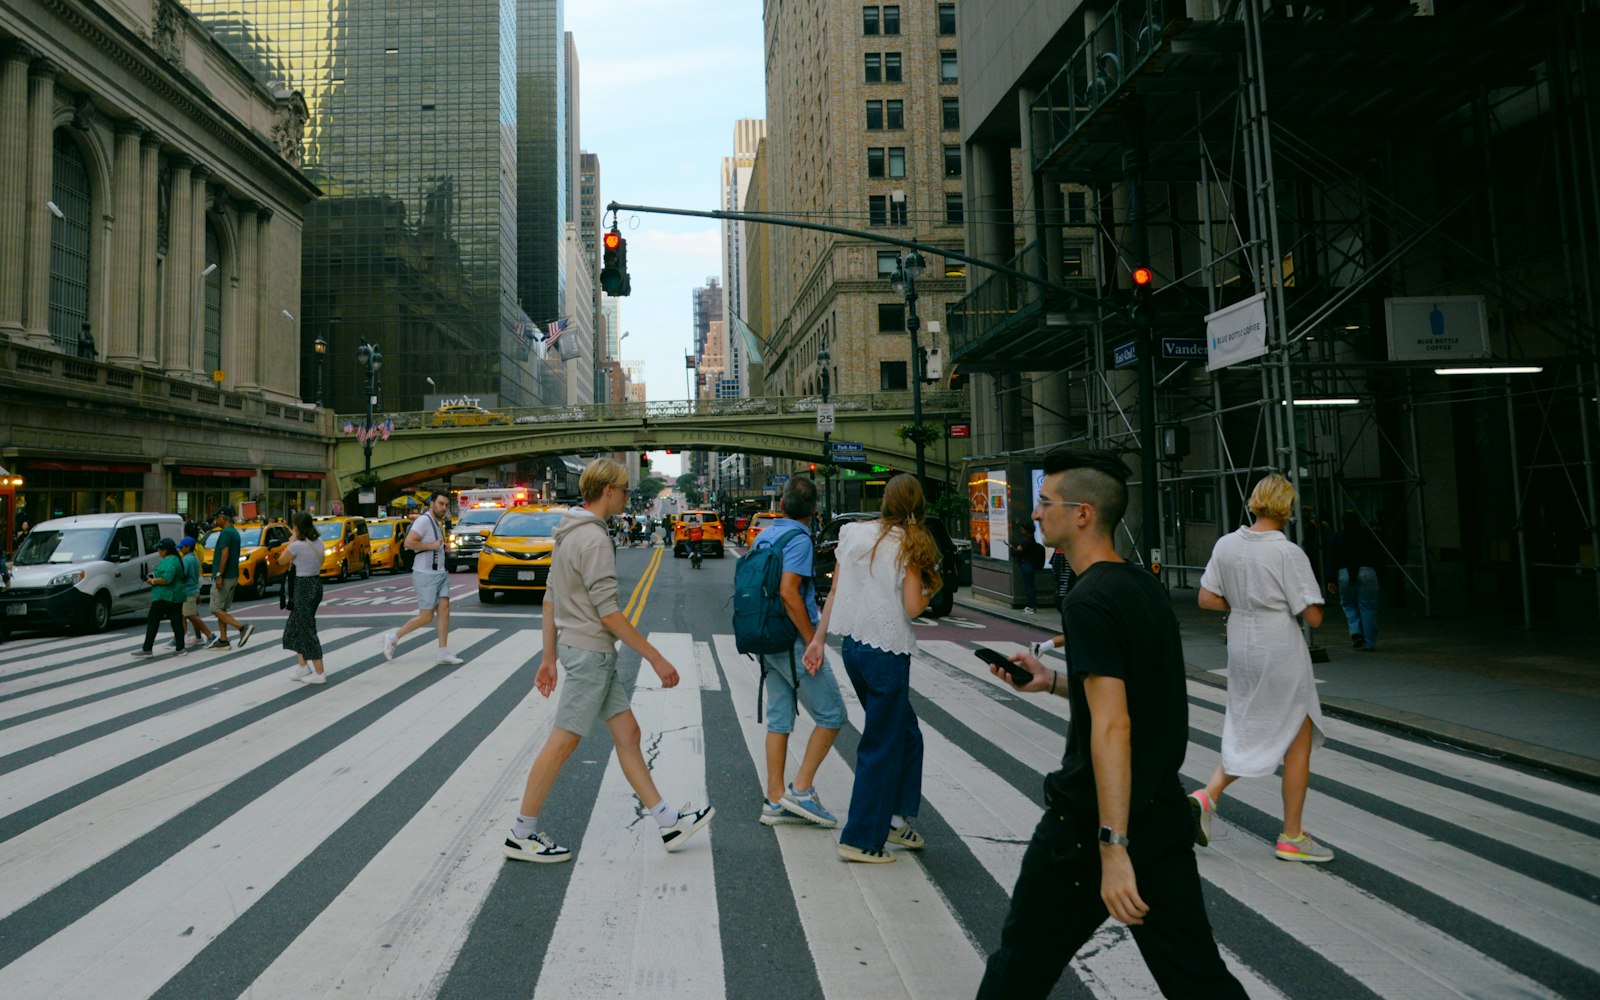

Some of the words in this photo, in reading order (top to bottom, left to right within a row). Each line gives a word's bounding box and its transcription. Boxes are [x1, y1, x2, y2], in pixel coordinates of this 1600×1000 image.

[1217, 335, 1228, 344] BLUE
[1228, 330, 1243, 341] BOTTLE
[1243, 322, 1260, 335] COFFEE
[1165, 342, 1208, 355] Vander
[440, 398, 481, 408] HYATT
[819, 415, 833, 423] 25
[681, 432, 746, 442] PERSHING
[754, 436, 804, 448] SQUARE
[425, 450, 469, 465] GRAND
[477, 440, 535, 455] CENTRAL
[543, 434, 609, 446] TERMINAL
